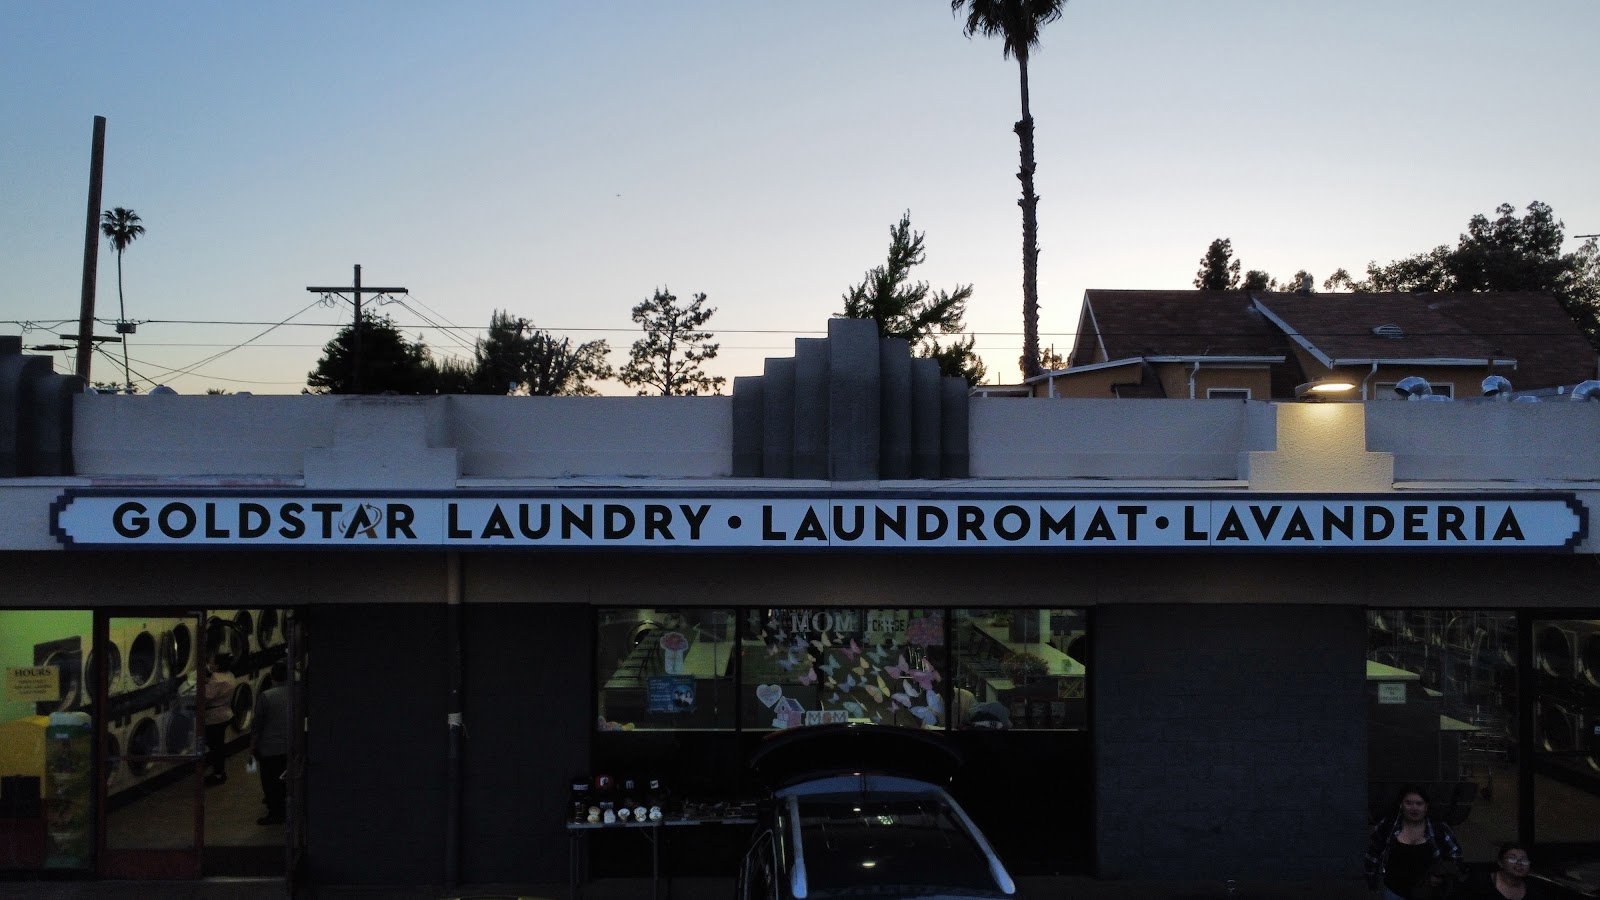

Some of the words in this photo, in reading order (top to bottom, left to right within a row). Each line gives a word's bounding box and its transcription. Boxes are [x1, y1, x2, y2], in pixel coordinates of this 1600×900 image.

[112, 502, 417, 540] GOLDSTAR
[448, 503, 711, 540] LAUNDRY
[762, 504, 1147, 541] LAUNDROMAT
[1184, 505, 1525, 541] LAVANDERIA
[792, 611, 854, 633] MOM
[15, 669, 51, 677] HOURS
